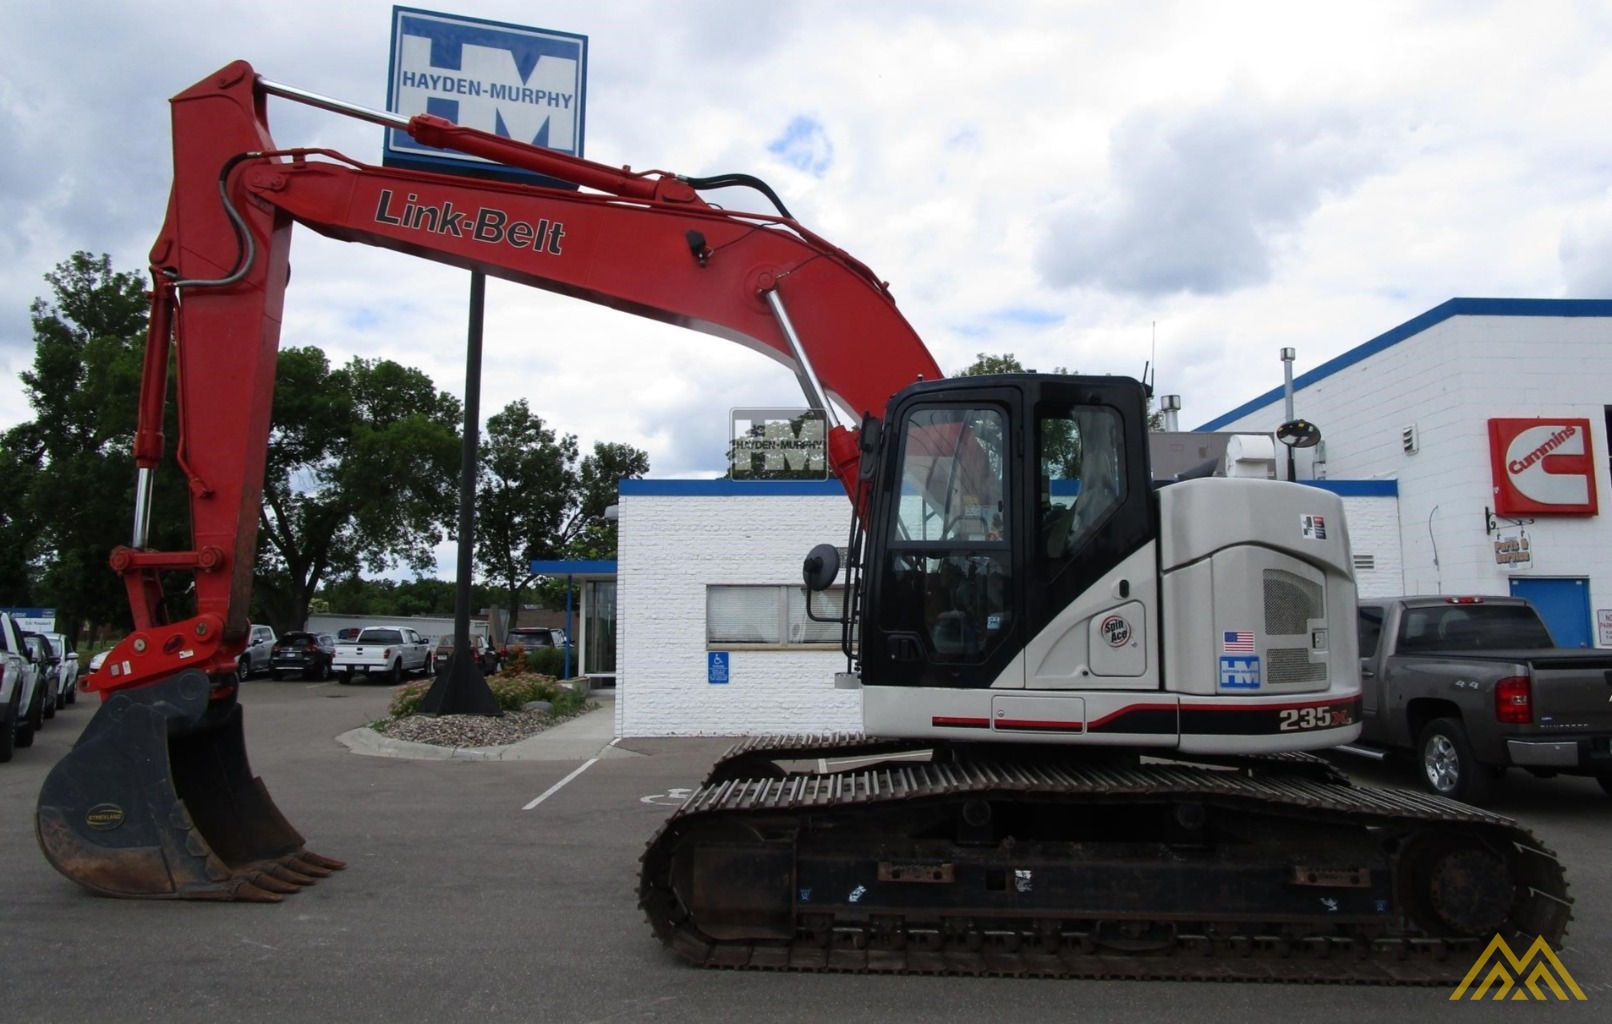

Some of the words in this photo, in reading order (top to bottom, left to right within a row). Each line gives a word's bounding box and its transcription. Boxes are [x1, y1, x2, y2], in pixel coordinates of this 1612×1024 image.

[402, 70, 573, 109] HAYDEN-MURPHY
[375, 189, 565, 255] Link-Belt
[1508, 426, 1576, 475] Cummins
[1105, 620, 1124, 633] Spin
[1111, 630, 1128, 642] Ace
[1455, 680, 1479, 689] 44
